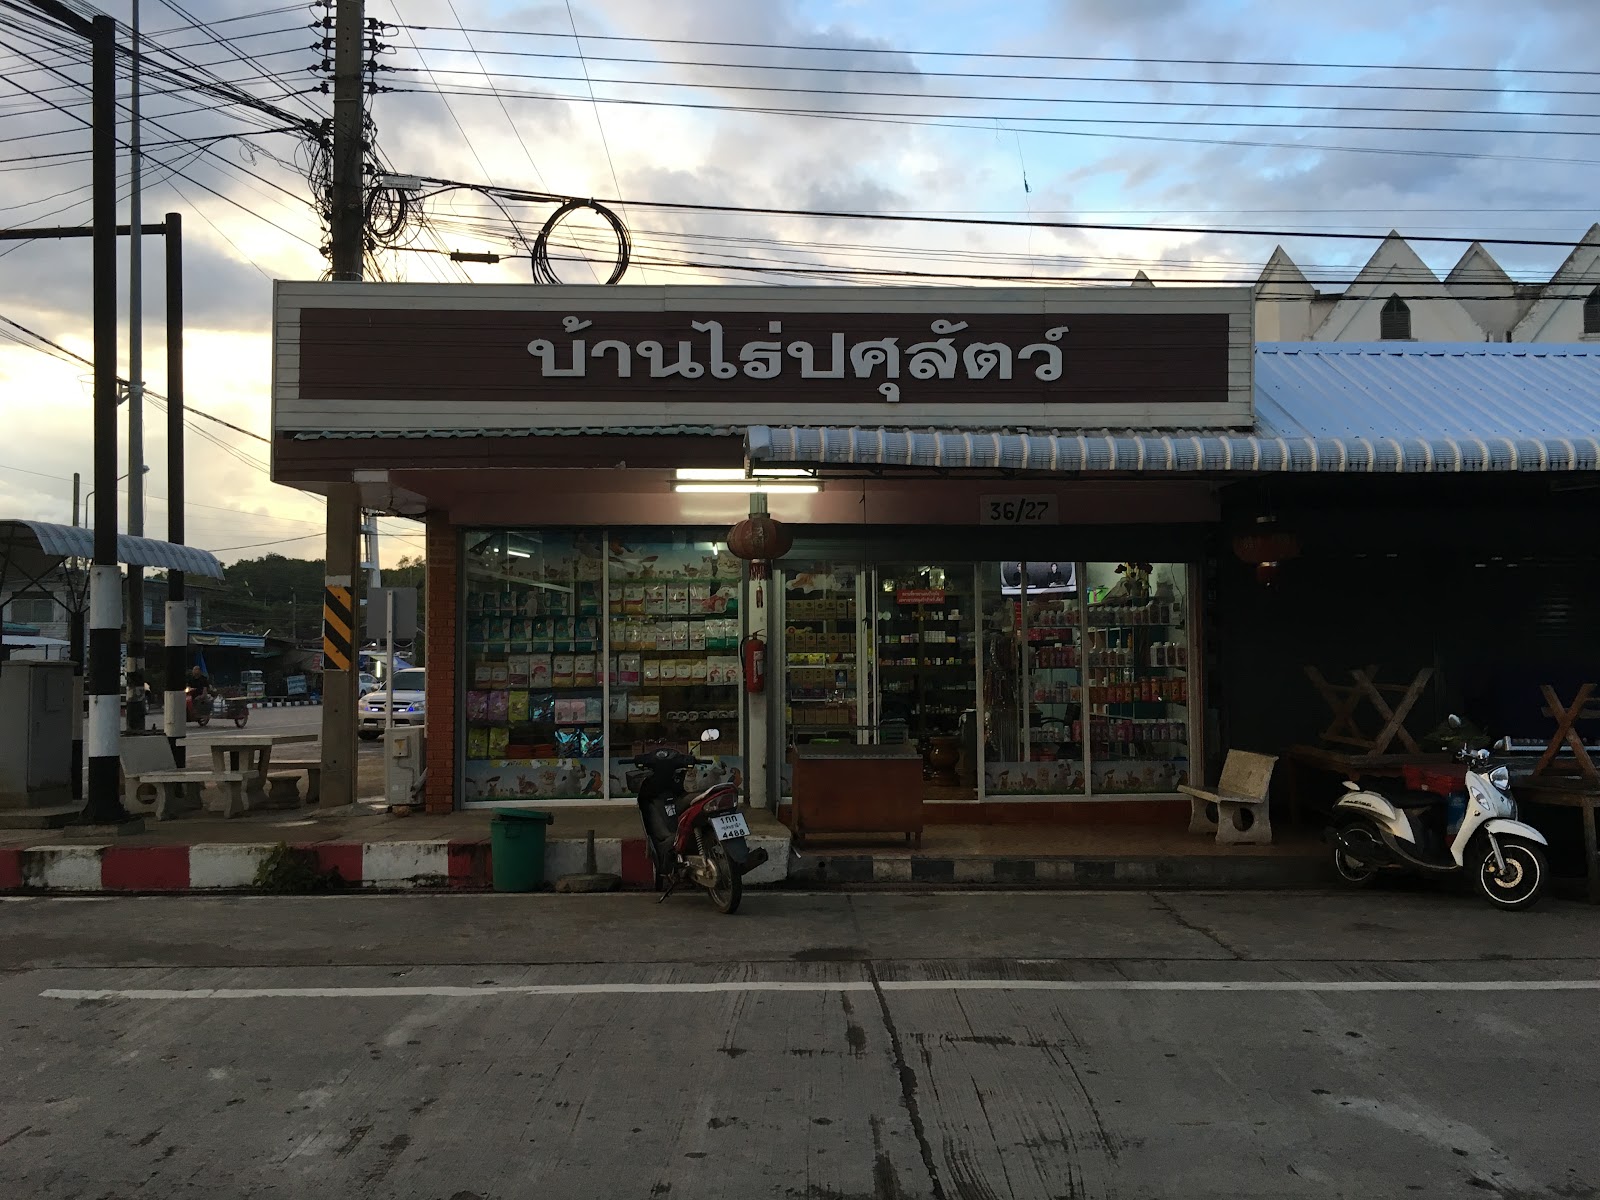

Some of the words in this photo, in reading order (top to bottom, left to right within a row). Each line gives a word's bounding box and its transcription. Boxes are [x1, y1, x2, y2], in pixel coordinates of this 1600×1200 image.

[527, 315, 1069, 402] บ้านไร่ปศุสัตว์
[990, 498, 1049, 523] 36/27
[723, 829, 745, 838] 4488
